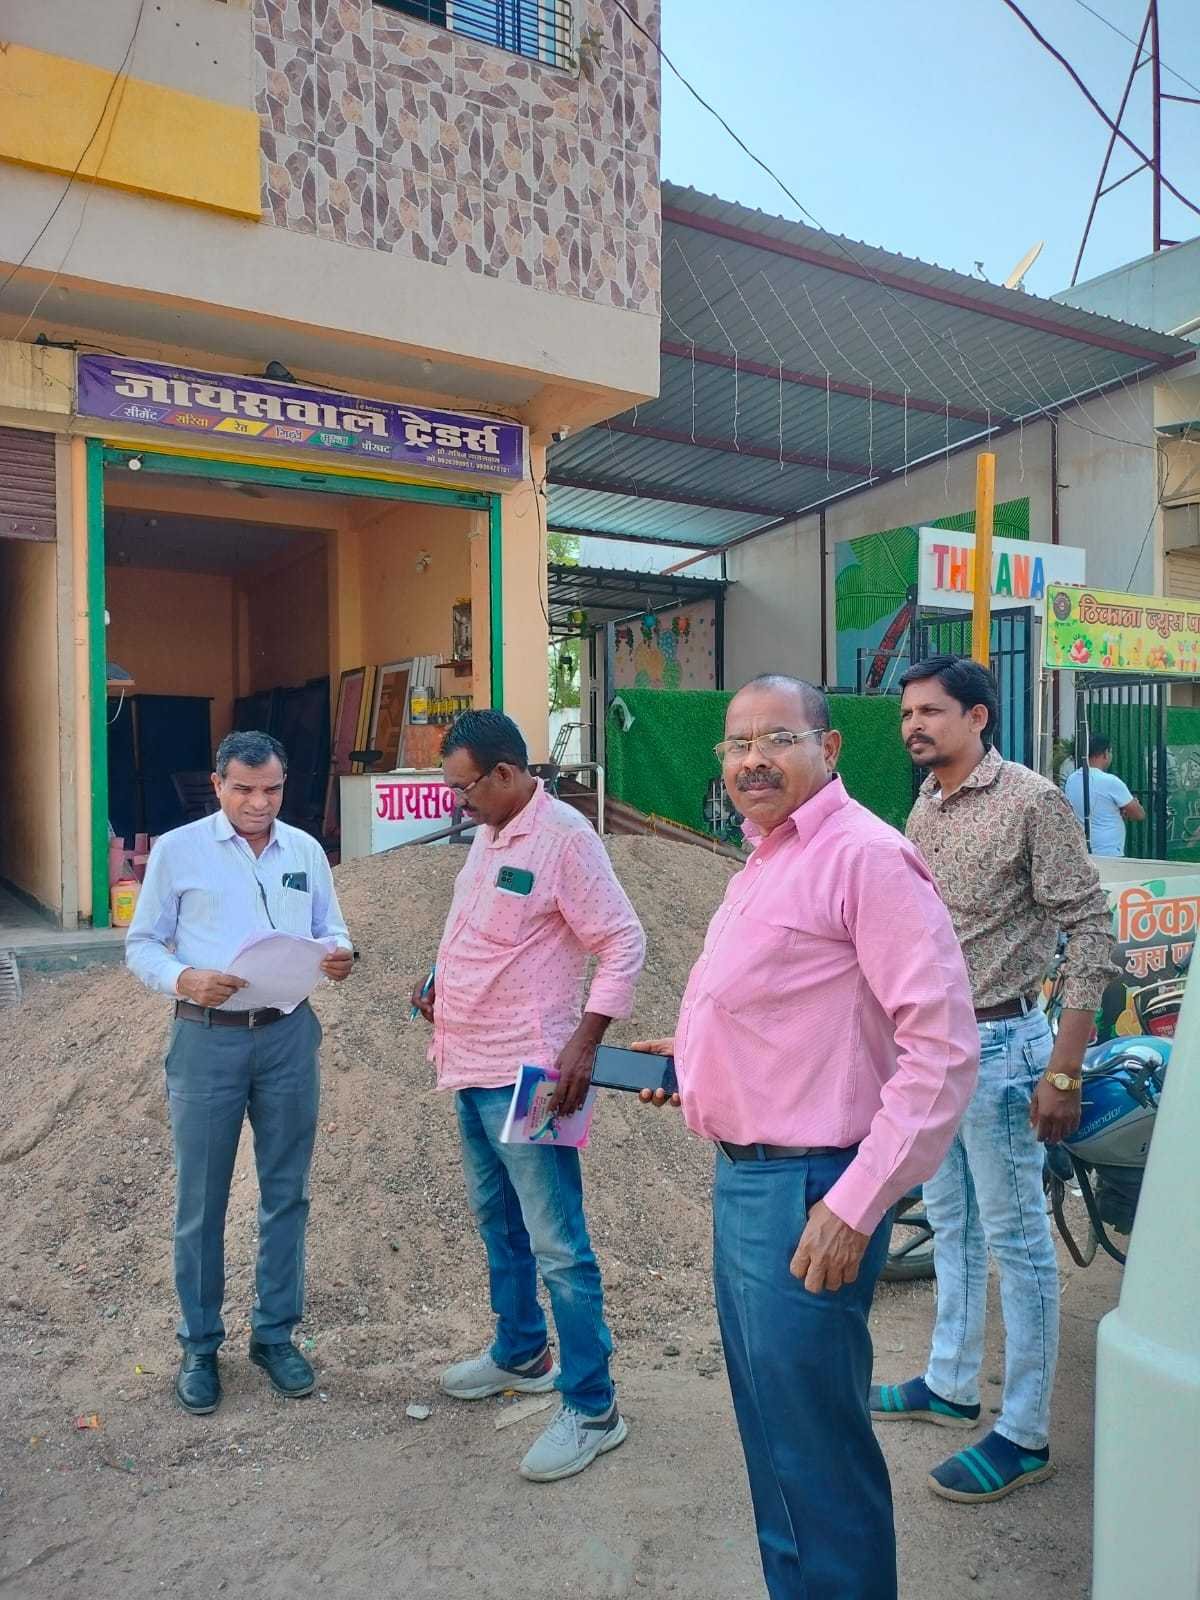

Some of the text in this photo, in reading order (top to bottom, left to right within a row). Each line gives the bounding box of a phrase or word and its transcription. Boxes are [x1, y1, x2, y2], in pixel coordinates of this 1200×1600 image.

[111, 370, 500, 454] जायसवाल ट्रेडर्स
[124, 405, 158, 420] सीमेंट
[932, 543, 1045, 600] THIANA
[1079, 594, 1143, 629] ठिकाना
